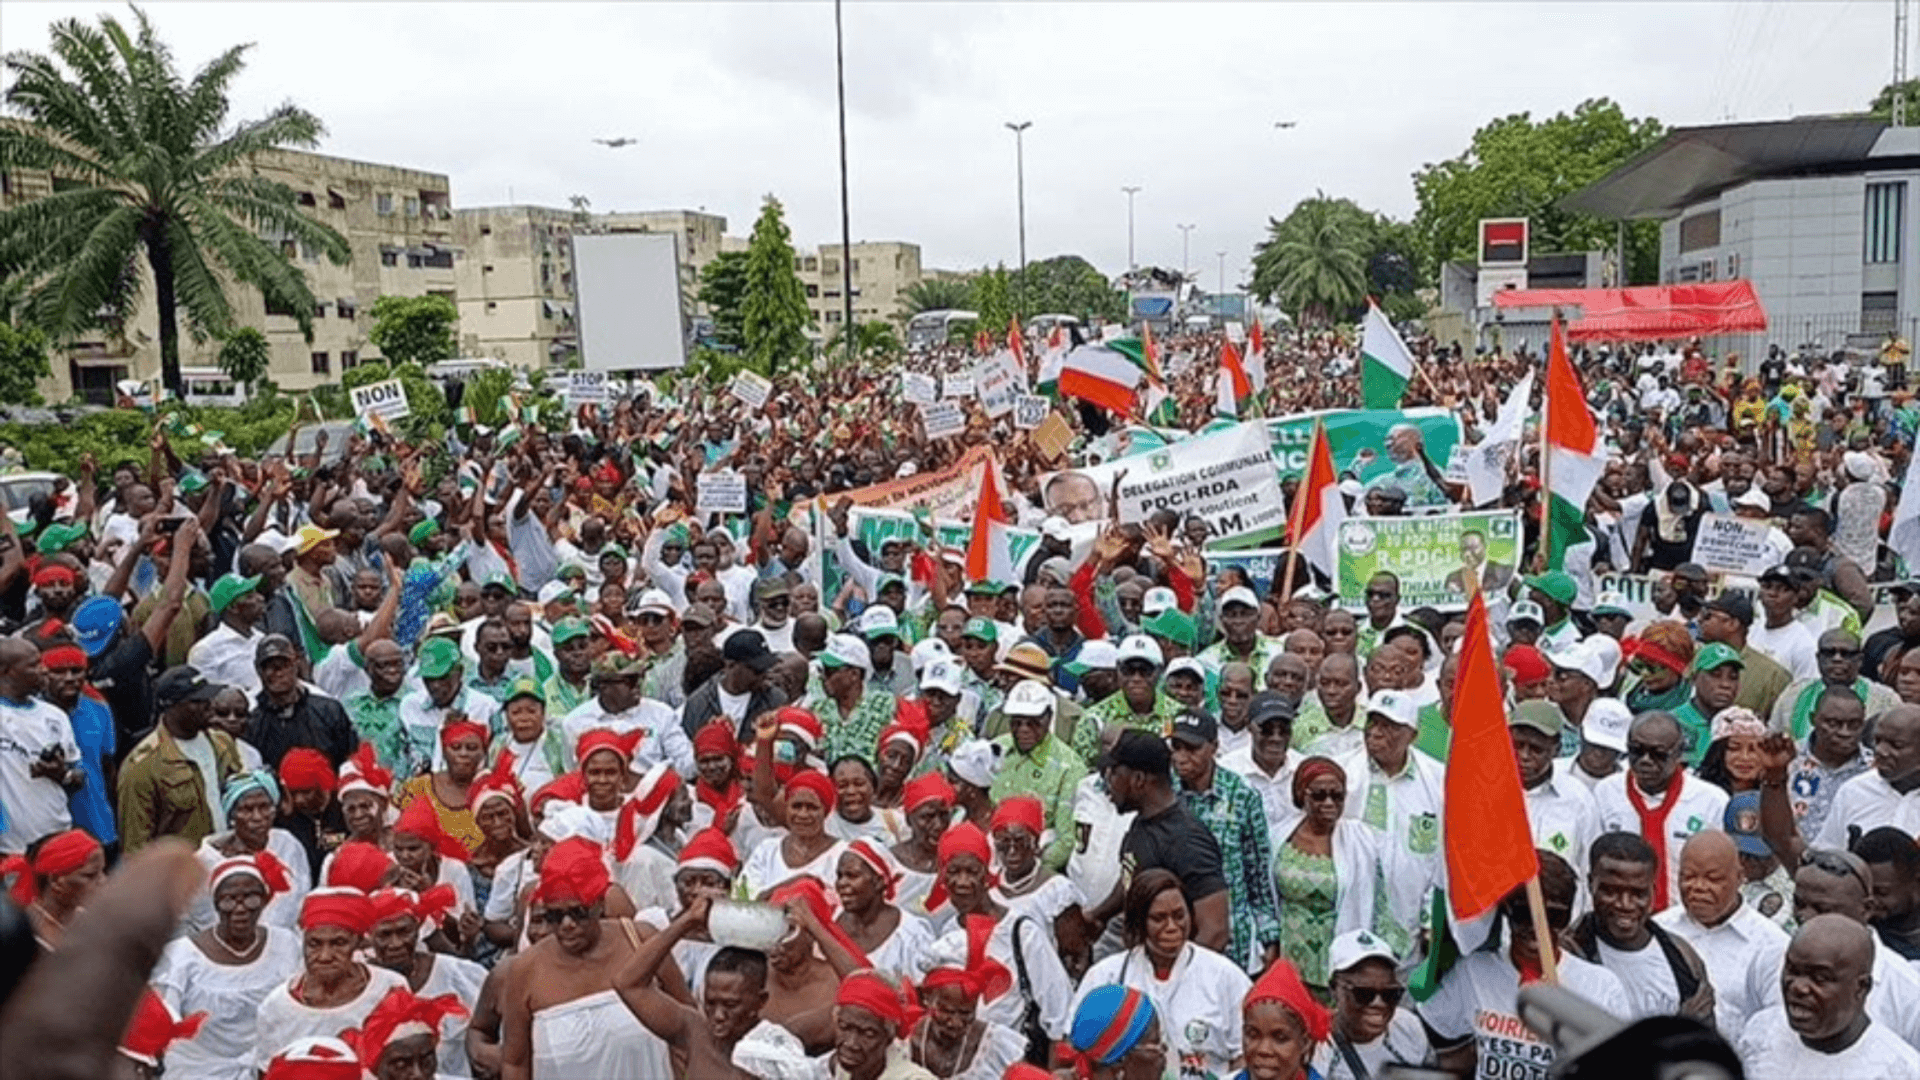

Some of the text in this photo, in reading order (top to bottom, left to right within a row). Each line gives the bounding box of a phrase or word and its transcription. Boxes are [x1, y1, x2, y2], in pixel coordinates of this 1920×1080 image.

[356, 382, 399, 406] NON
[1122, 450, 1272, 498] DELEGATION COMMUNALE
[1140, 478, 1240, 512] PDCI-RDA
[1200, 492, 1259, 516] soutient
[1713, 519, 1744, 534] NON
